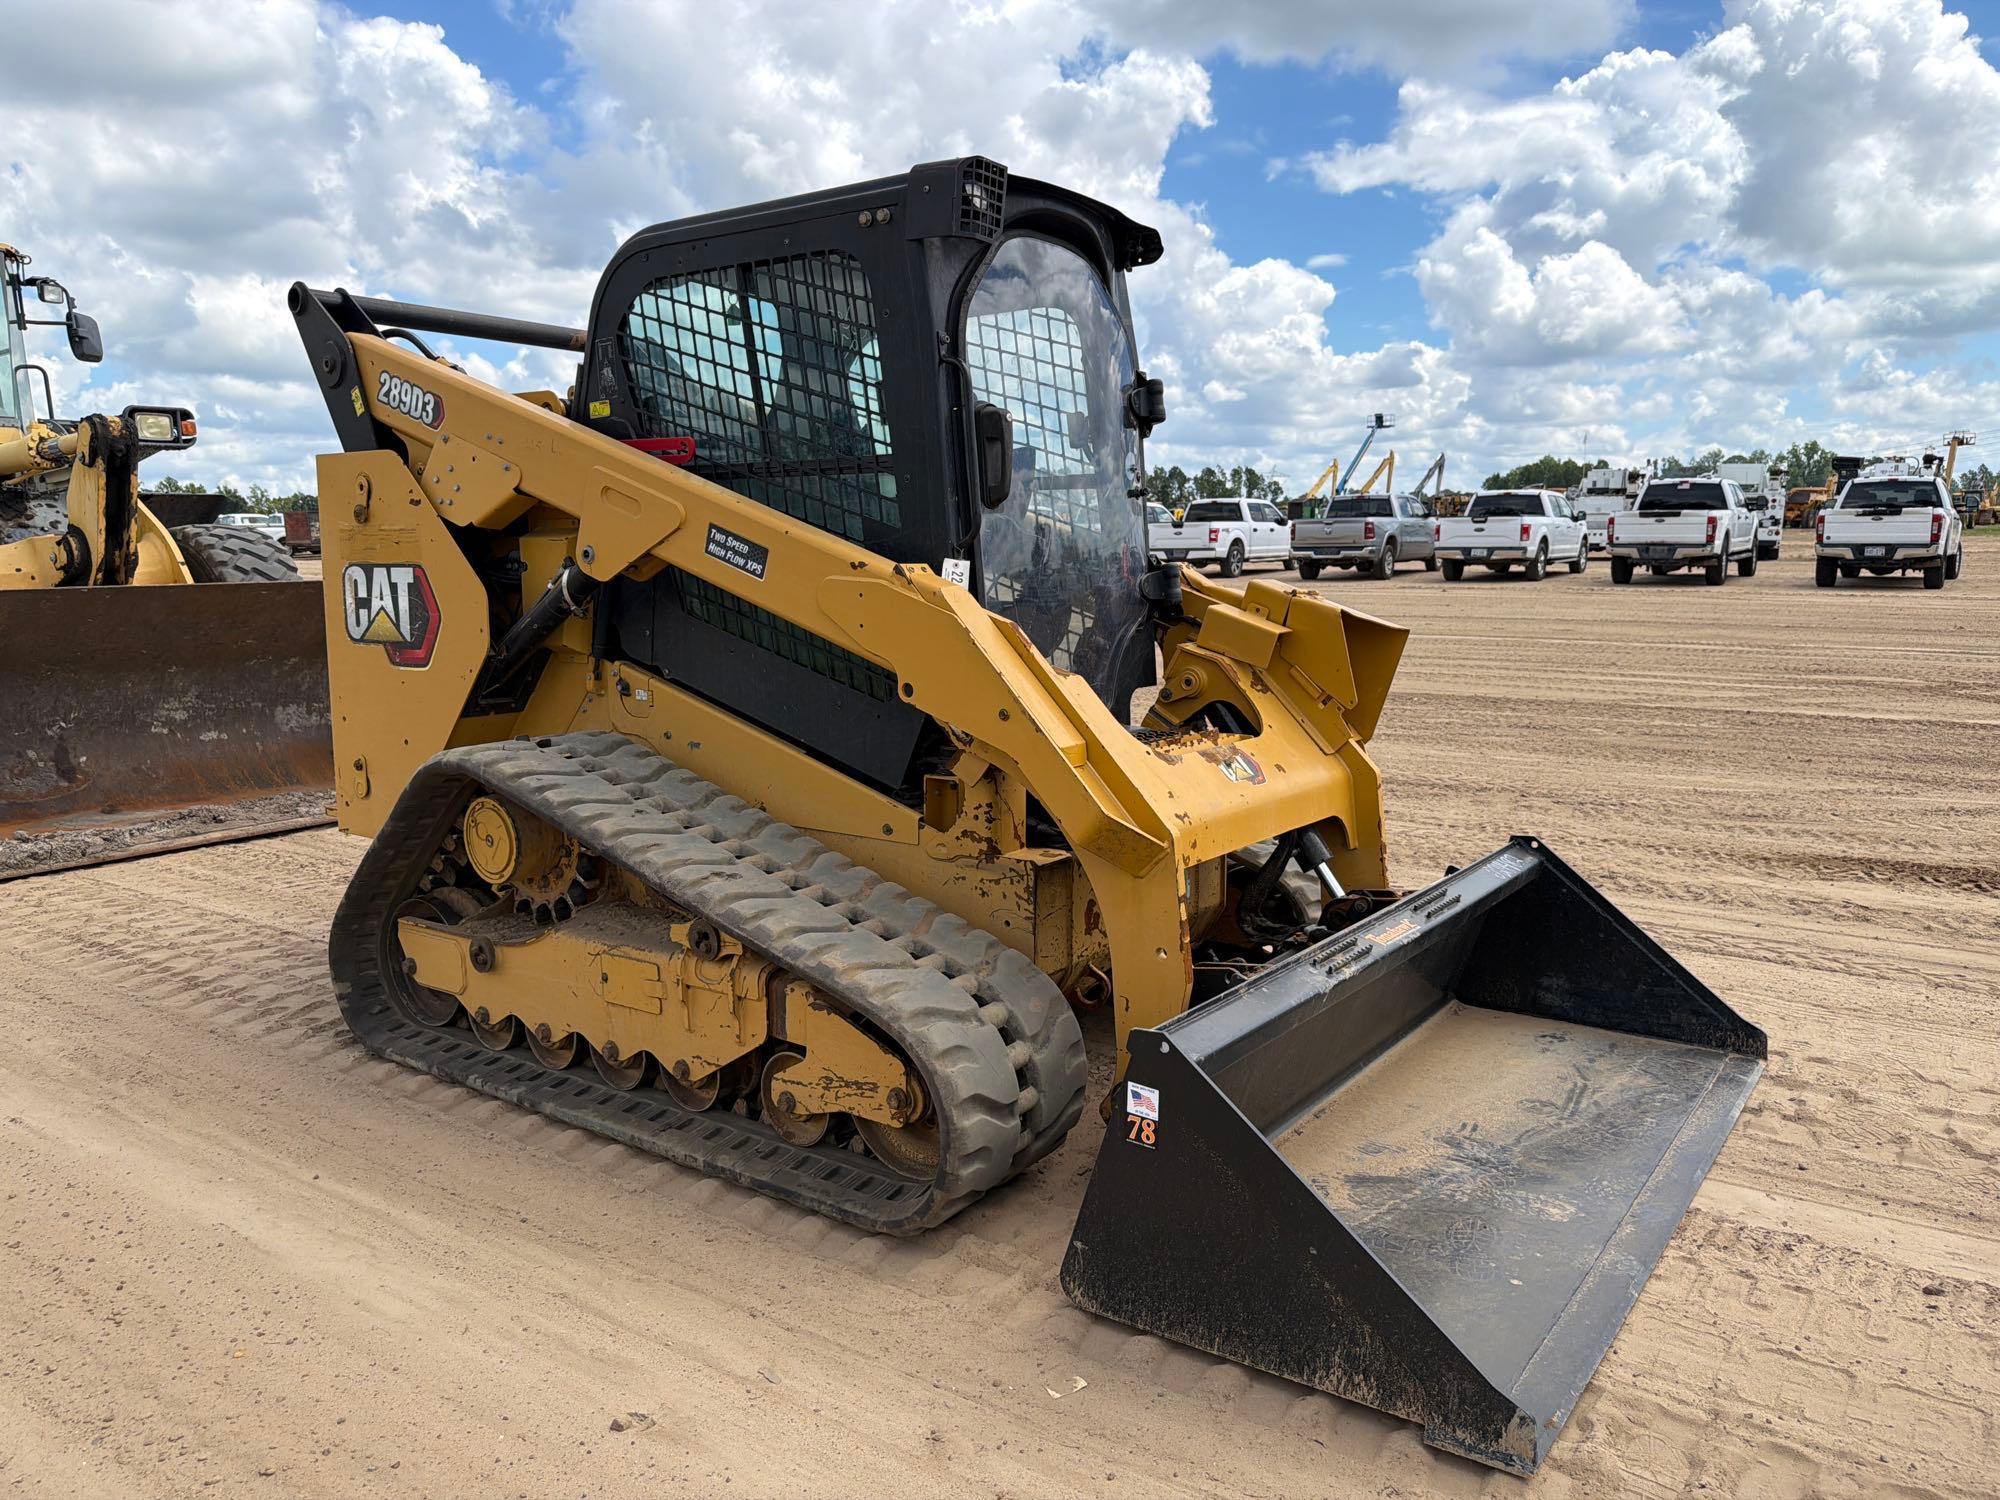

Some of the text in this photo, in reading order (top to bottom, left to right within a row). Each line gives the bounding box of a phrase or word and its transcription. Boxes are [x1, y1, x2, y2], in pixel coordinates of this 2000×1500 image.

[378, 372, 435, 424] 289D3
[746, 560, 763, 575] XPS
[345, 566, 414, 642] CAT
[1127, 1114, 1156, 1145] 78
